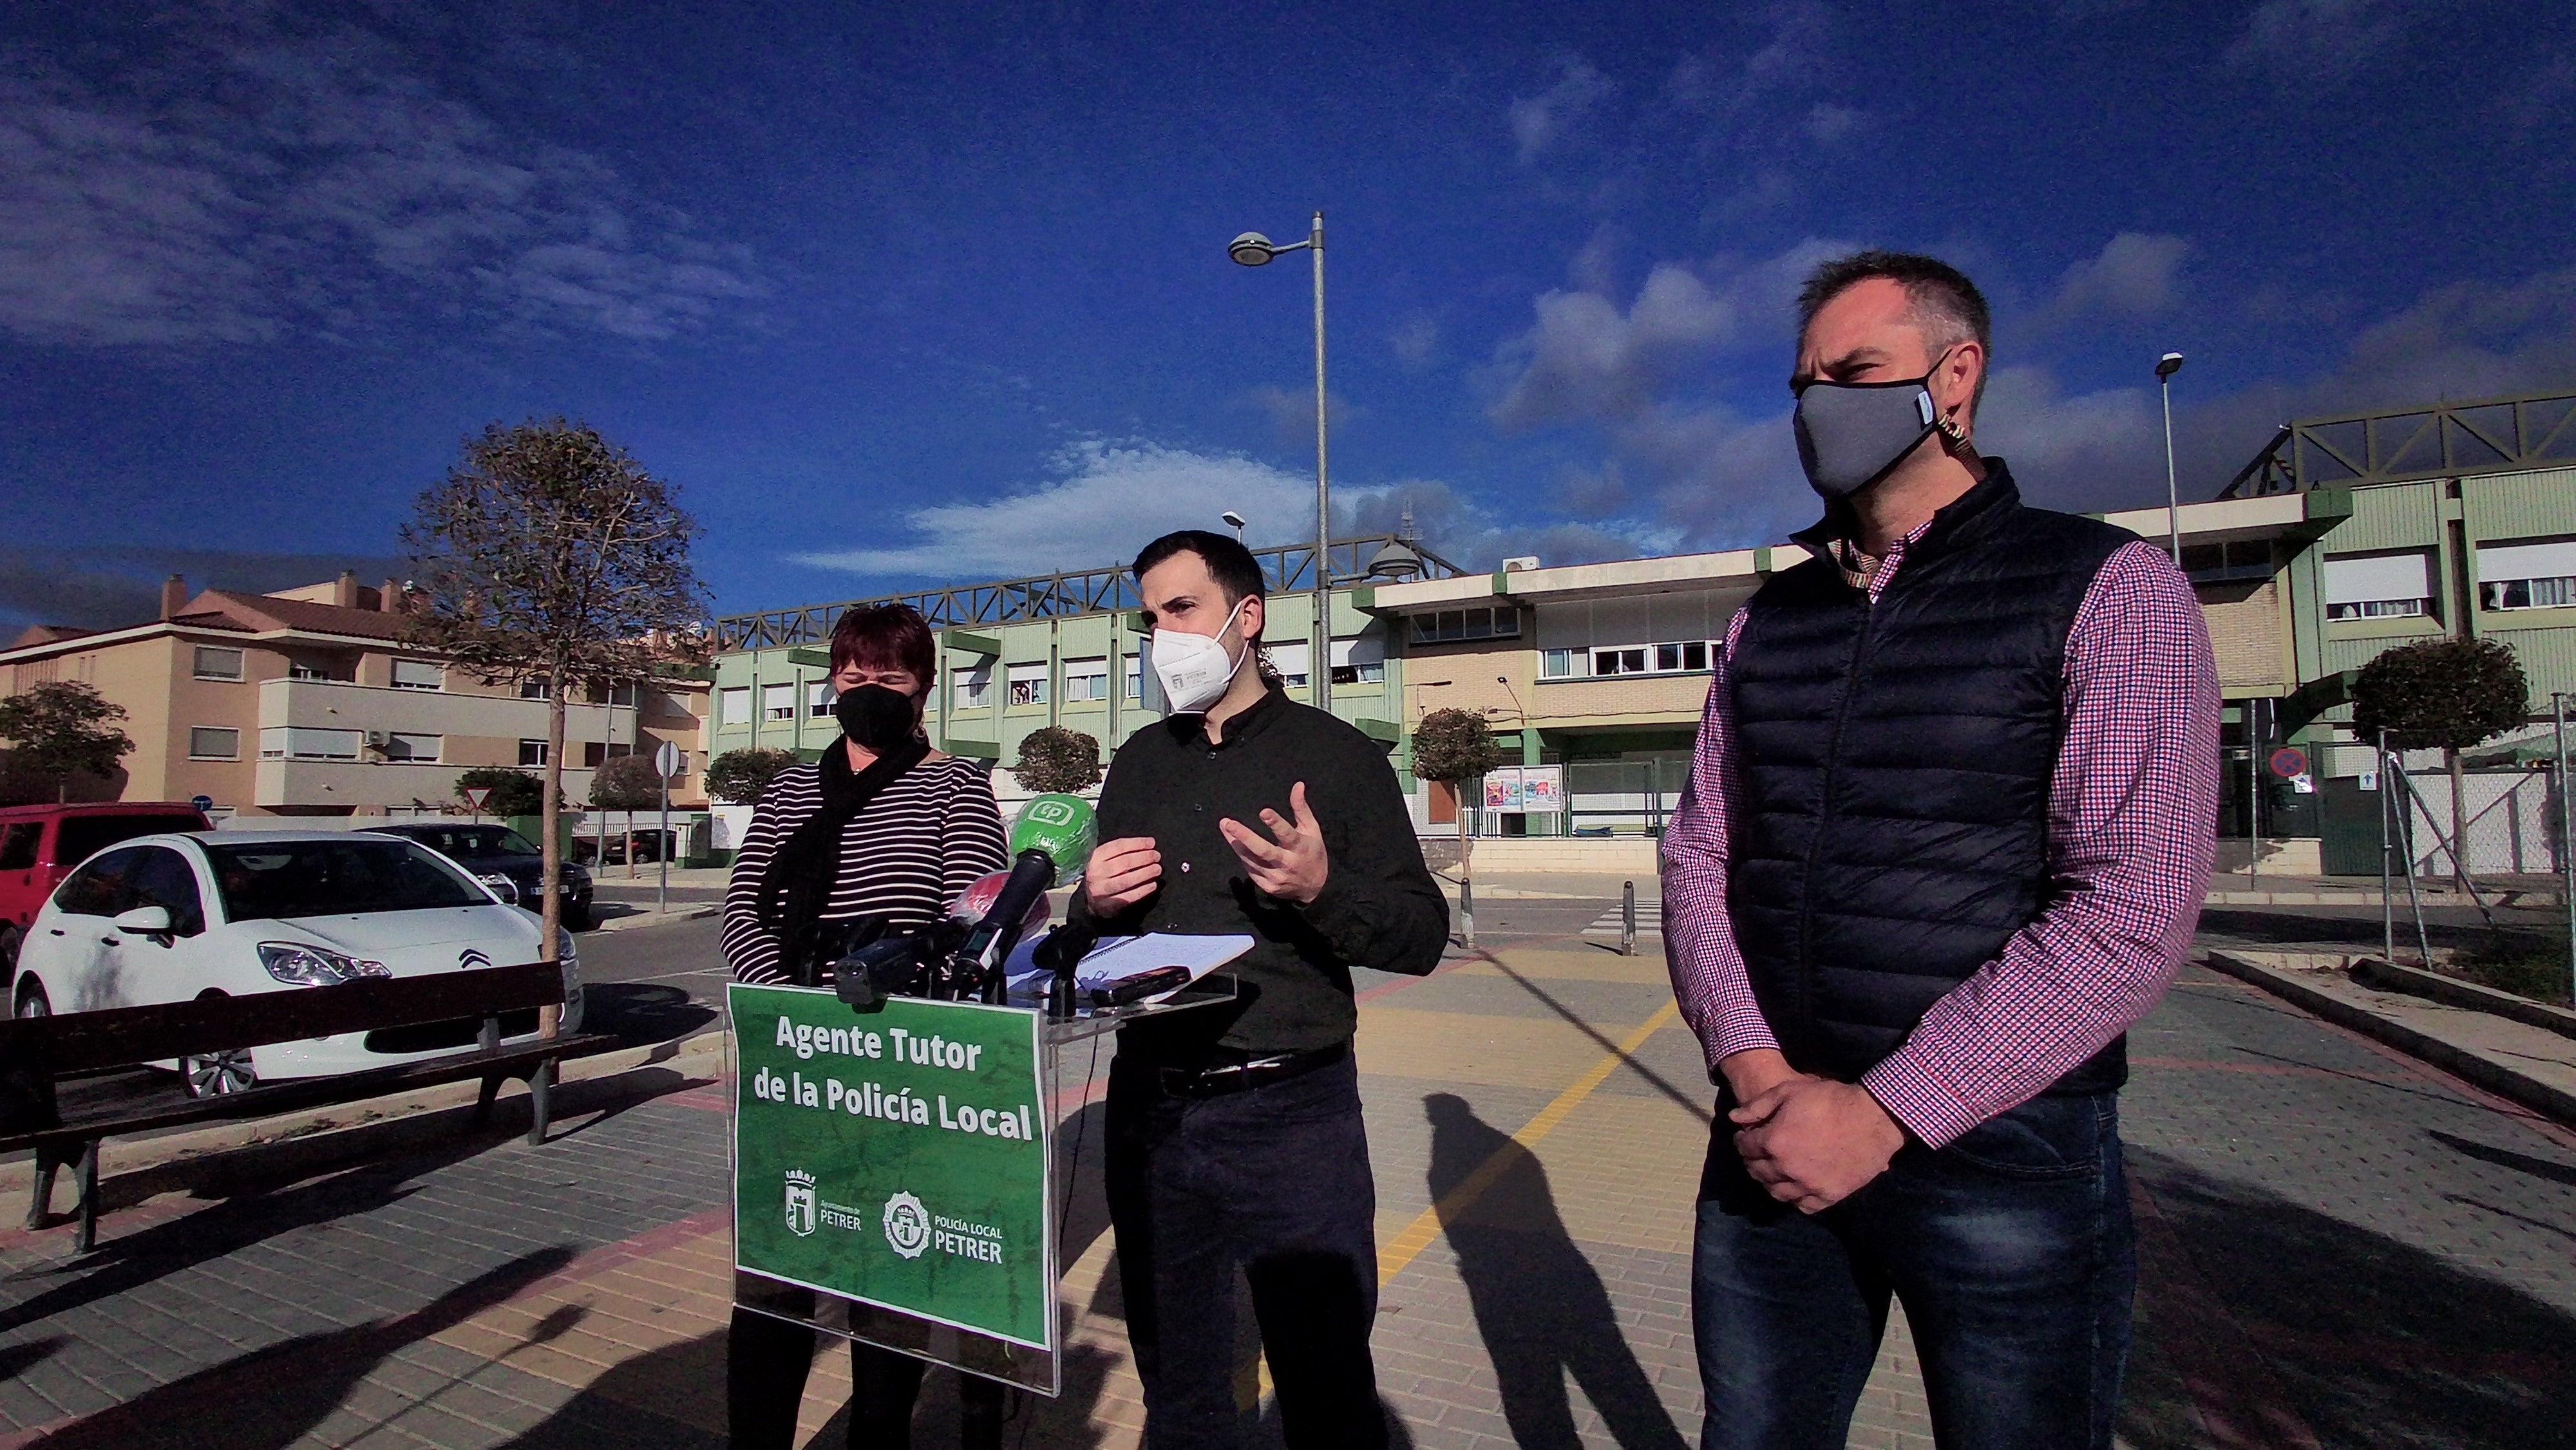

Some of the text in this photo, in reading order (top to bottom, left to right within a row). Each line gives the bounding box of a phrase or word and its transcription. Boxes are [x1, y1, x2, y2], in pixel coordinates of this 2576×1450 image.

[776, 1015, 981, 1071] Agente Tutor
[754, 1066, 1032, 1141] de la Policía Local
[820, 1209, 862, 1231] PETRER
[934, 1215, 1003, 1239] POLICÍA LOCAL
[934, 1229, 1003, 1265] PETRER
